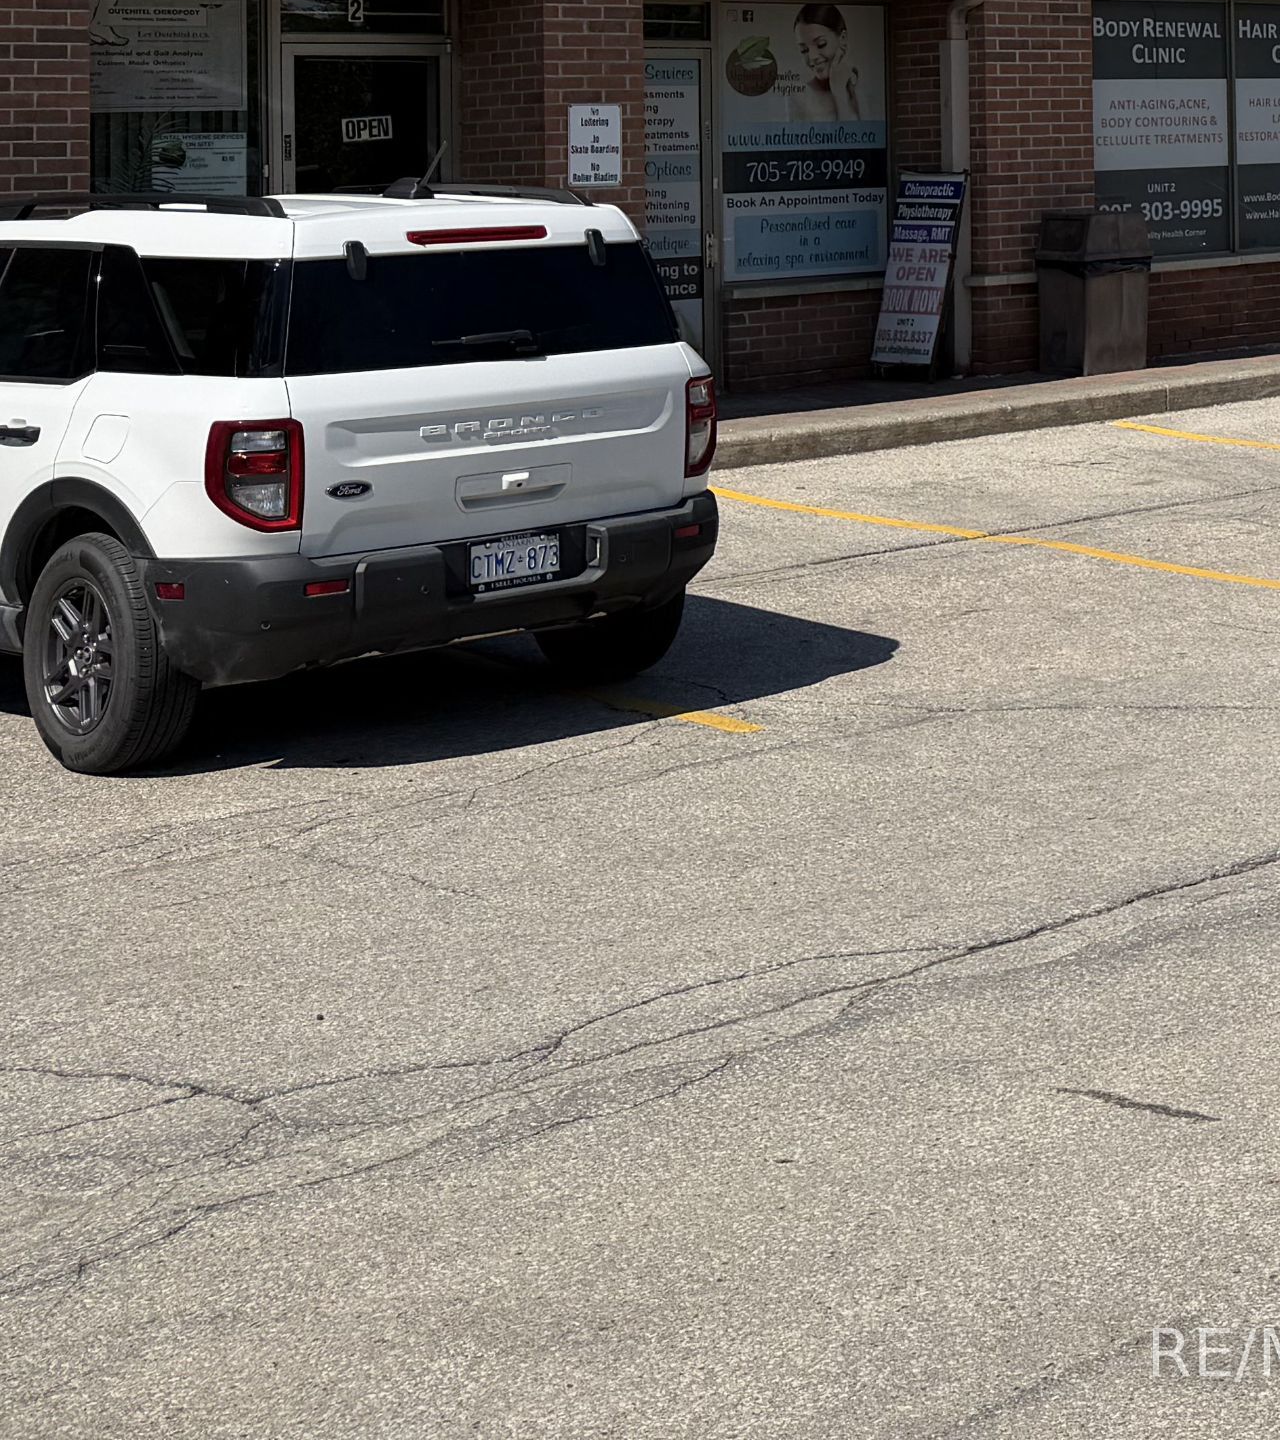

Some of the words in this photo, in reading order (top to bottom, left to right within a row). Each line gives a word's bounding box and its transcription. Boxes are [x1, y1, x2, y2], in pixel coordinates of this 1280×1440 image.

[350, 0, 362, 21] 2
[172, 50, 203, 58] Analysis
[644, 63, 694, 80] Services
[643, 91, 685, 99] ssments
[1249, 98, 1272, 108] HAIR
[590, 107, 599, 115] No
[345, 117, 390, 140] OPEN
[580, 117, 609, 127] Loitering
[1100, 117, 1131, 129] BODY
[1135, 116, 1201, 128] CONTOURING
[1204, 116, 1217, 126] &
[644, 131, 690, 139] eatments
[727, 126, 876, 148] www.naturalsmiles.ca
[1096, 135, 1151, 146] CELLULITE
[1154, 133, 1223, 145] TREATMENTS
[571, 145, 589, 154] Skate
[590, 145, 619, 155] Boarding
[591, 163, 600, 172] No
[644, 161, 692, 180] Options
[747, 159, 866, 183] 705-718-9949
[572, 173, 592, 182] Roller
[594, 172, 618, 183] Blading
[645, 189, 667, 199] hing
[904, 182, 955, 197] Chiropractic
[727, 197, 756, 209] Book
[759, 196, 775, 208] An
[778, 194, 849, 209] Appointment
[853, 192, 885, 207] Today
[897, 204, 953, 220] Physiotherapy
[646, 214, 696, 225] Whitening
[835, 219, 857, 231] care
[893, 225, 929, 242] Massage,
[931, 227, 950, 241] RMT
[1147, 231, 1161, 241] lity
[1162, 229, 1184, 239] Health
[1184, 228, 1206, 237] Corner
[799, 235, 808, 246] in
[814, 237, 820, 246] a
[736, 254, 780, 271] relaxing
[785, 253, 804, 268] spa
[809, 246, 869, 264] environment
[892, 247, 914, 262] WE
[918, 248, 948, 263] ARE
[683, 263, 698, 276] to
[896, 266, 937, 281] OPEN
[664, 282, 697, 296] nce
[883, 289, 911, 312] BOOK
[912, 290, 940, 312] NOW
[420, 407, 601, 437] BRONCO
[337, 484, 363, 496] Ford
[472, 550, 516, 578] CTMZ
[527, 544, 559, 570] 873
